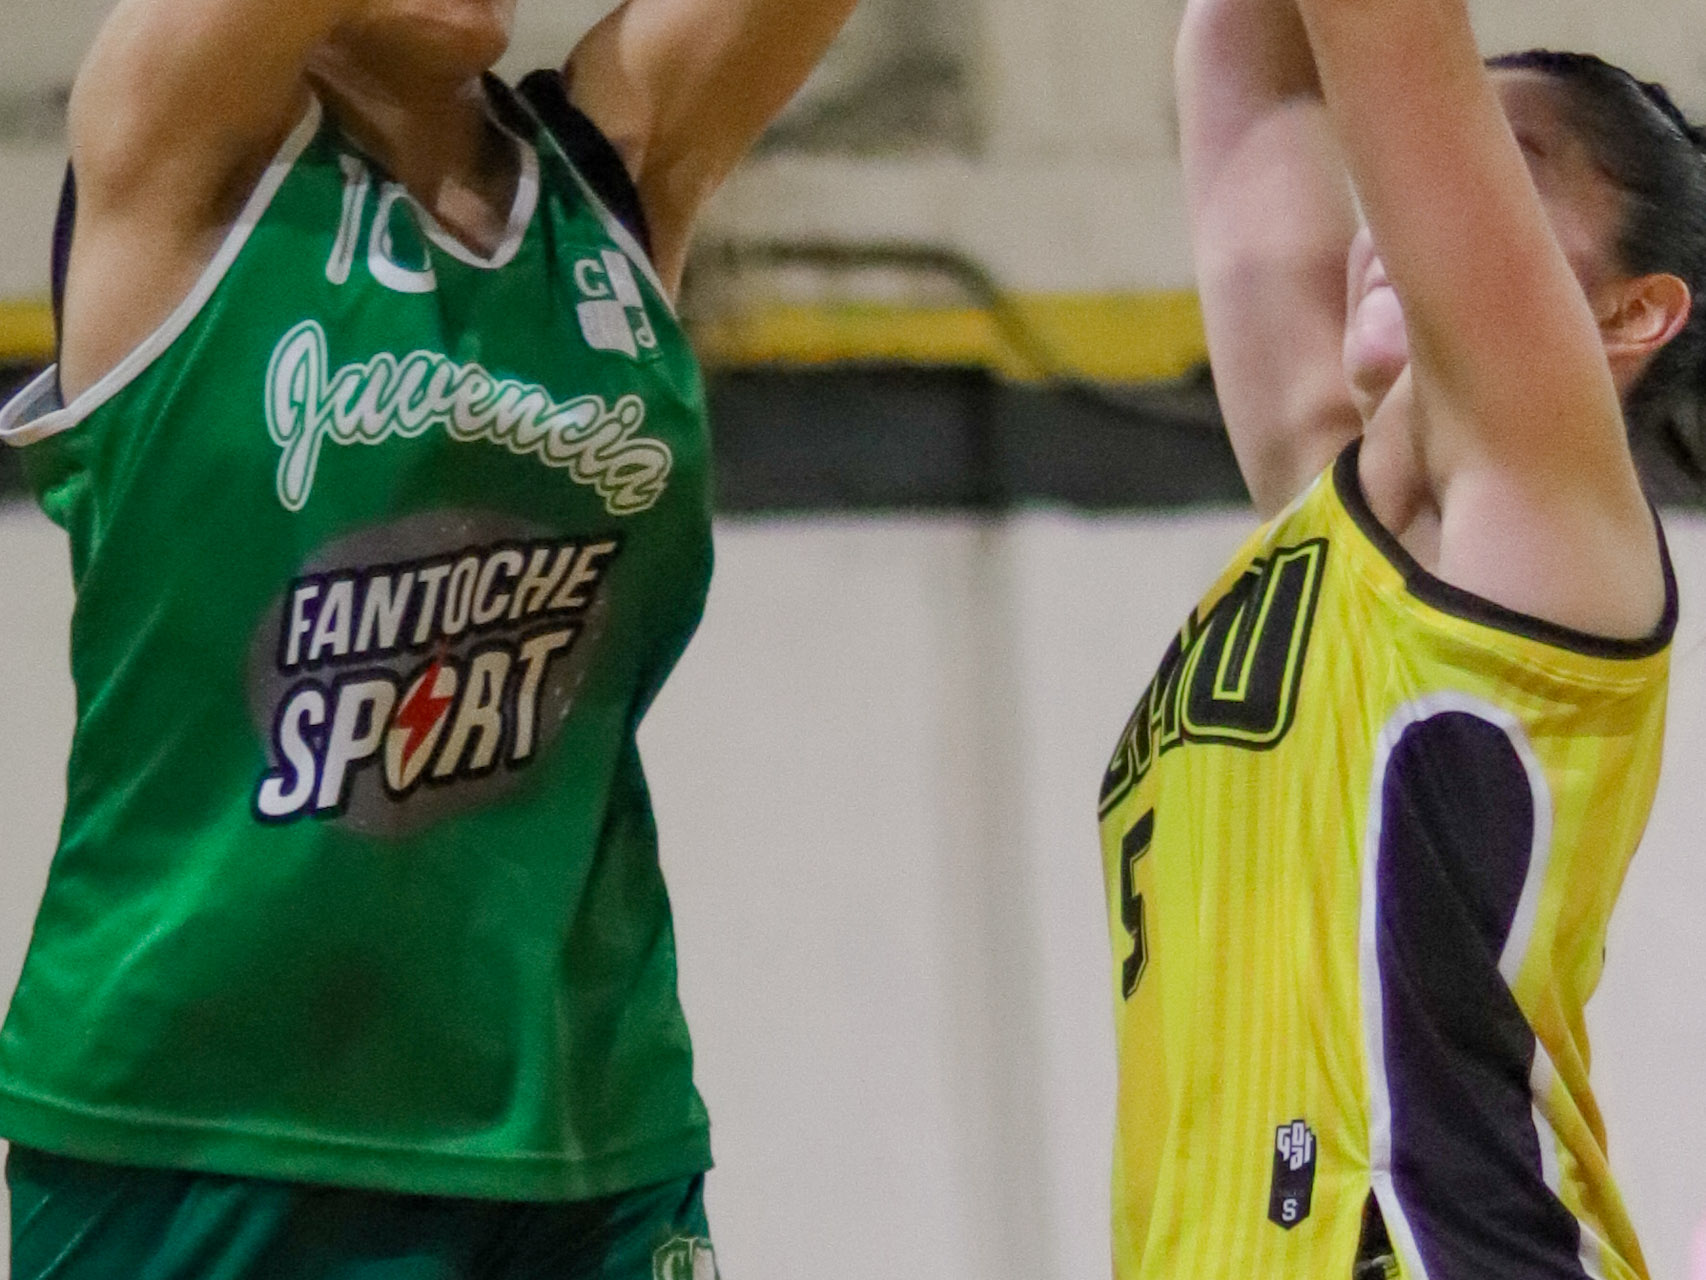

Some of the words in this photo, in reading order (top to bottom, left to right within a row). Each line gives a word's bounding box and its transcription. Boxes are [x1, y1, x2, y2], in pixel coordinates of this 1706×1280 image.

[264, 319, 673, 516] Juvencia
[284, 540, 619, 667] FANTOCHE
[257, 627, 575, 817] SPORT
[1281, 1197, 1299, 1222] S
